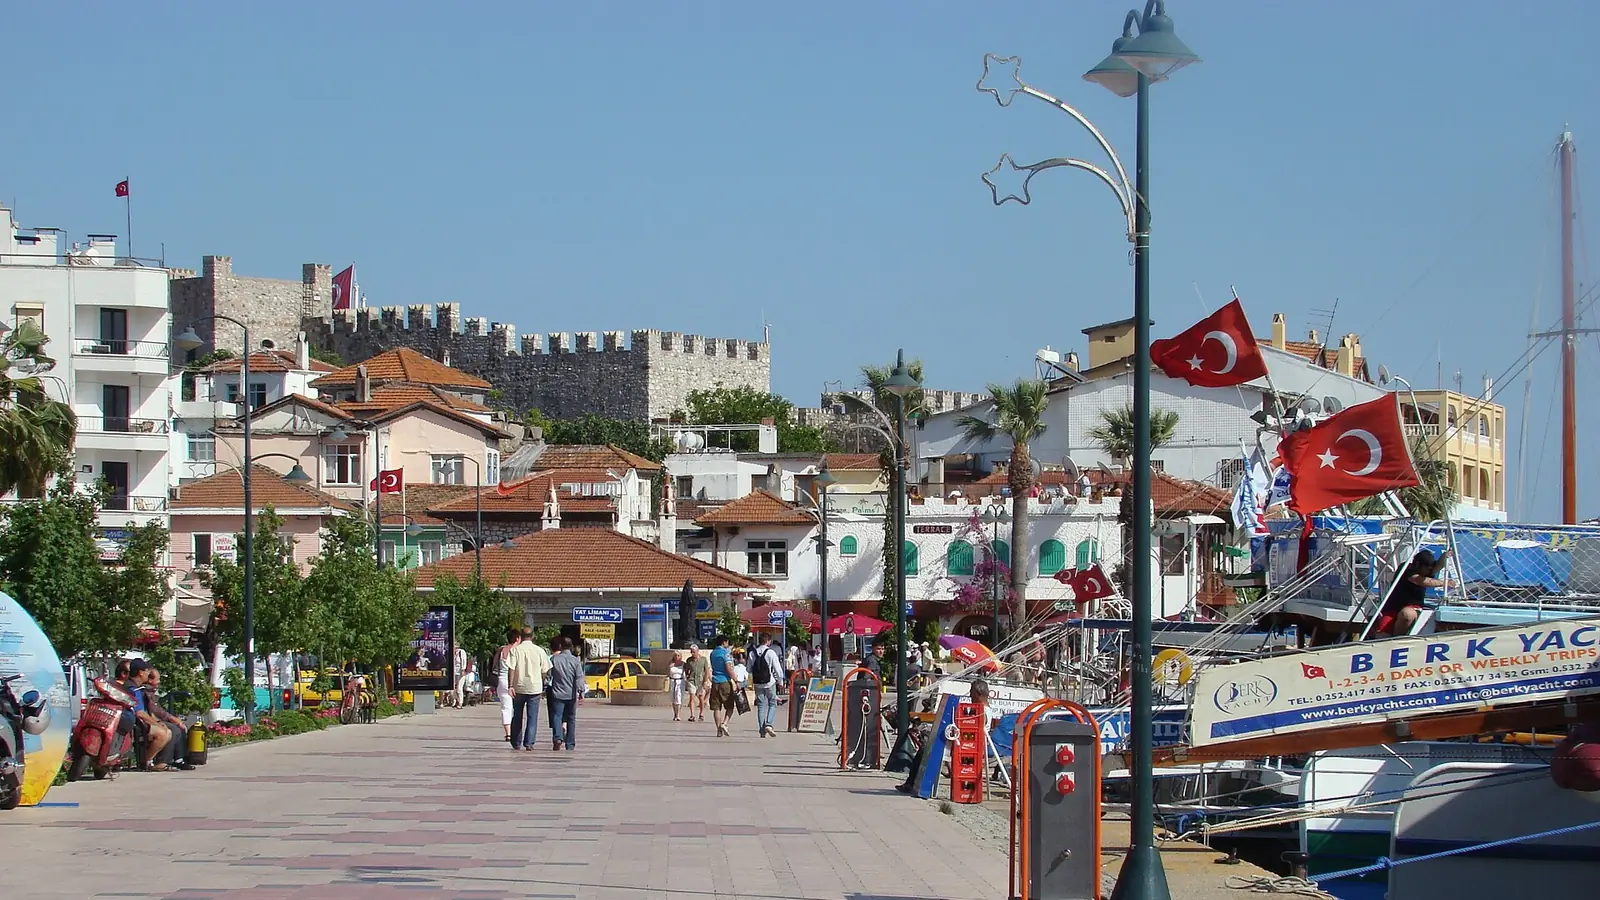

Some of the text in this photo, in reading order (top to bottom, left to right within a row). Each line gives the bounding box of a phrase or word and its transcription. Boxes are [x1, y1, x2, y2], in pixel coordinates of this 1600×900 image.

[1350, 626, 1600, 674] BERK YAC
[1328, 647, 1597, 689] 1-2-3-4 DAYS OR WEEKLY TRIPS
[1223, 695, 1272, 710] YACHT
[1288, 697, 1314, 706] TEL:
[1315, 689, 1366, 702] 0.252.417
[1368, 687, 1382, 695] 45
[1384, 684, 1398, 693] 75
[1403, 681, 1432, 690] FAX:
[1434, 674, 1485, 687] 0.252.417
[1488, 672, 1502, 680] 34
[1504, 669, 1518, 678] 52
[1520, 668, 1550, 678] Gsm:
[1454, 677, 1594, 702] info@berkyacht.com
[1300, 695, 1437, 720] www.berkyacht.com
